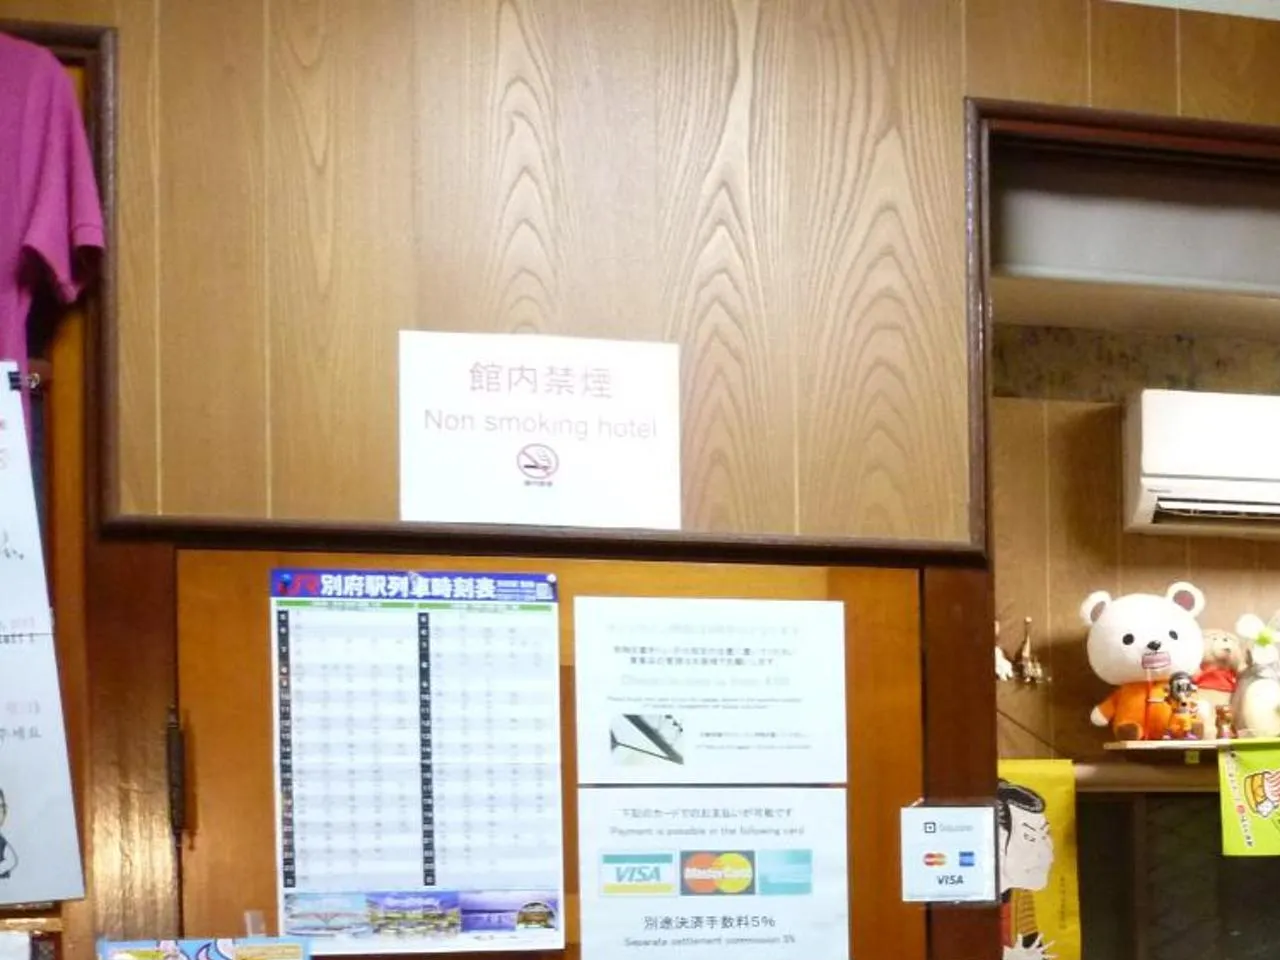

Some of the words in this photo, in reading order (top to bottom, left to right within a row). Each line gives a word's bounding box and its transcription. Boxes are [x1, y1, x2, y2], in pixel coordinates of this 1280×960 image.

[468, 361, 613, 400] 館内禁煙
[423, 408, 475, 432] Non
[484, 411, 588, 441] smoking
[597, 415, 658, 439] hotel
[319, 573, 497, 600] 別府駅列車時刻表
[614, 866, 663, 883] VISA
[936, 874, 964, 885] VISA
[643, 915, 776, 931] 別途決済手数料5%
